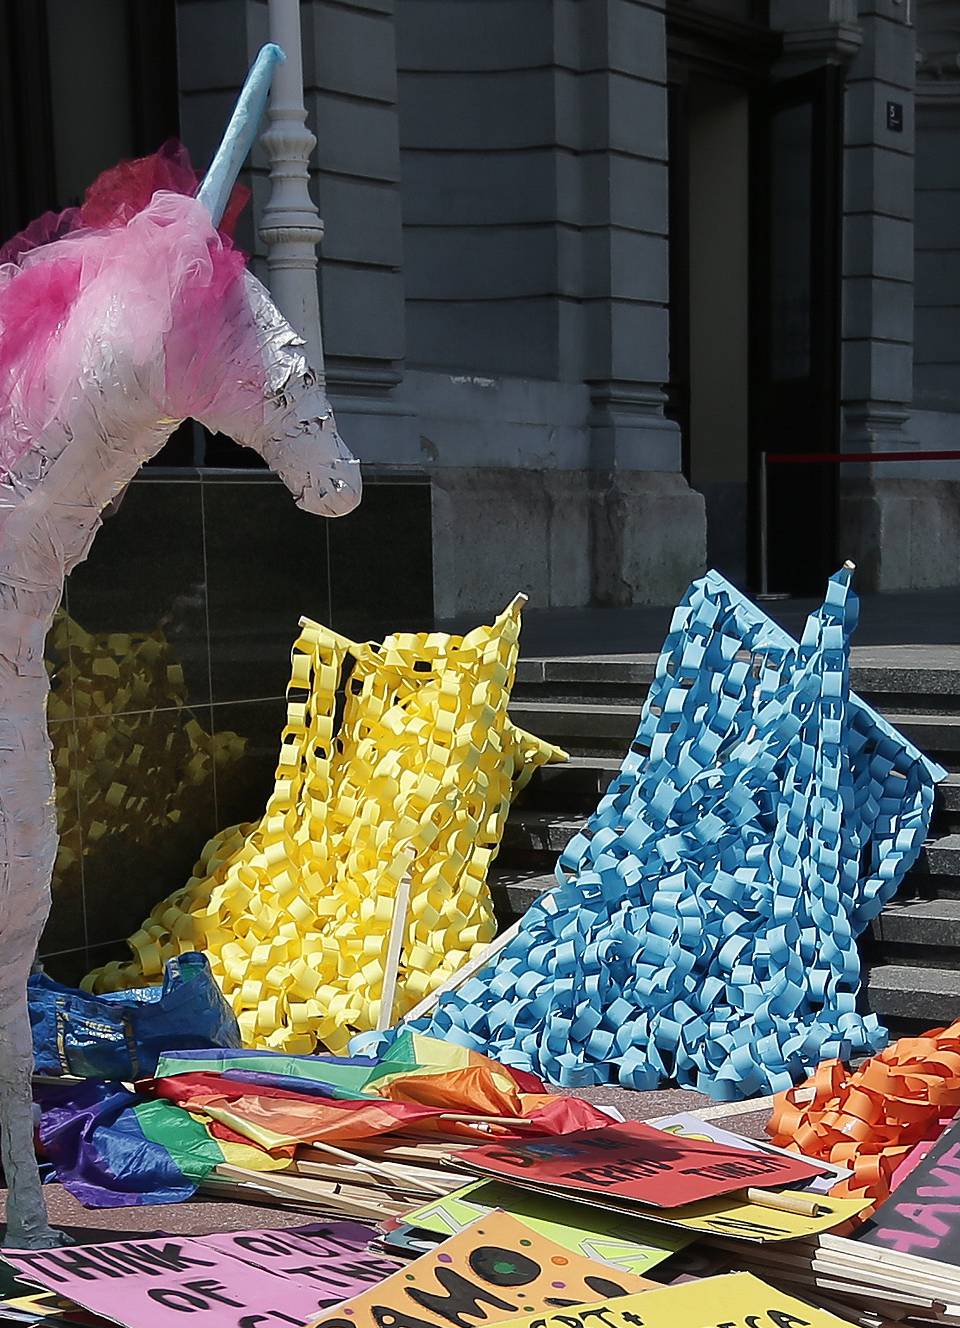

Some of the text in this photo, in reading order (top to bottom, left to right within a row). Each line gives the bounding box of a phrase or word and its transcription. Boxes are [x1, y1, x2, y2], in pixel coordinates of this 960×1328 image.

[6, 1228, 354, 1282] THINK OUT
[146, 1258, 400, 1313] OF THE
